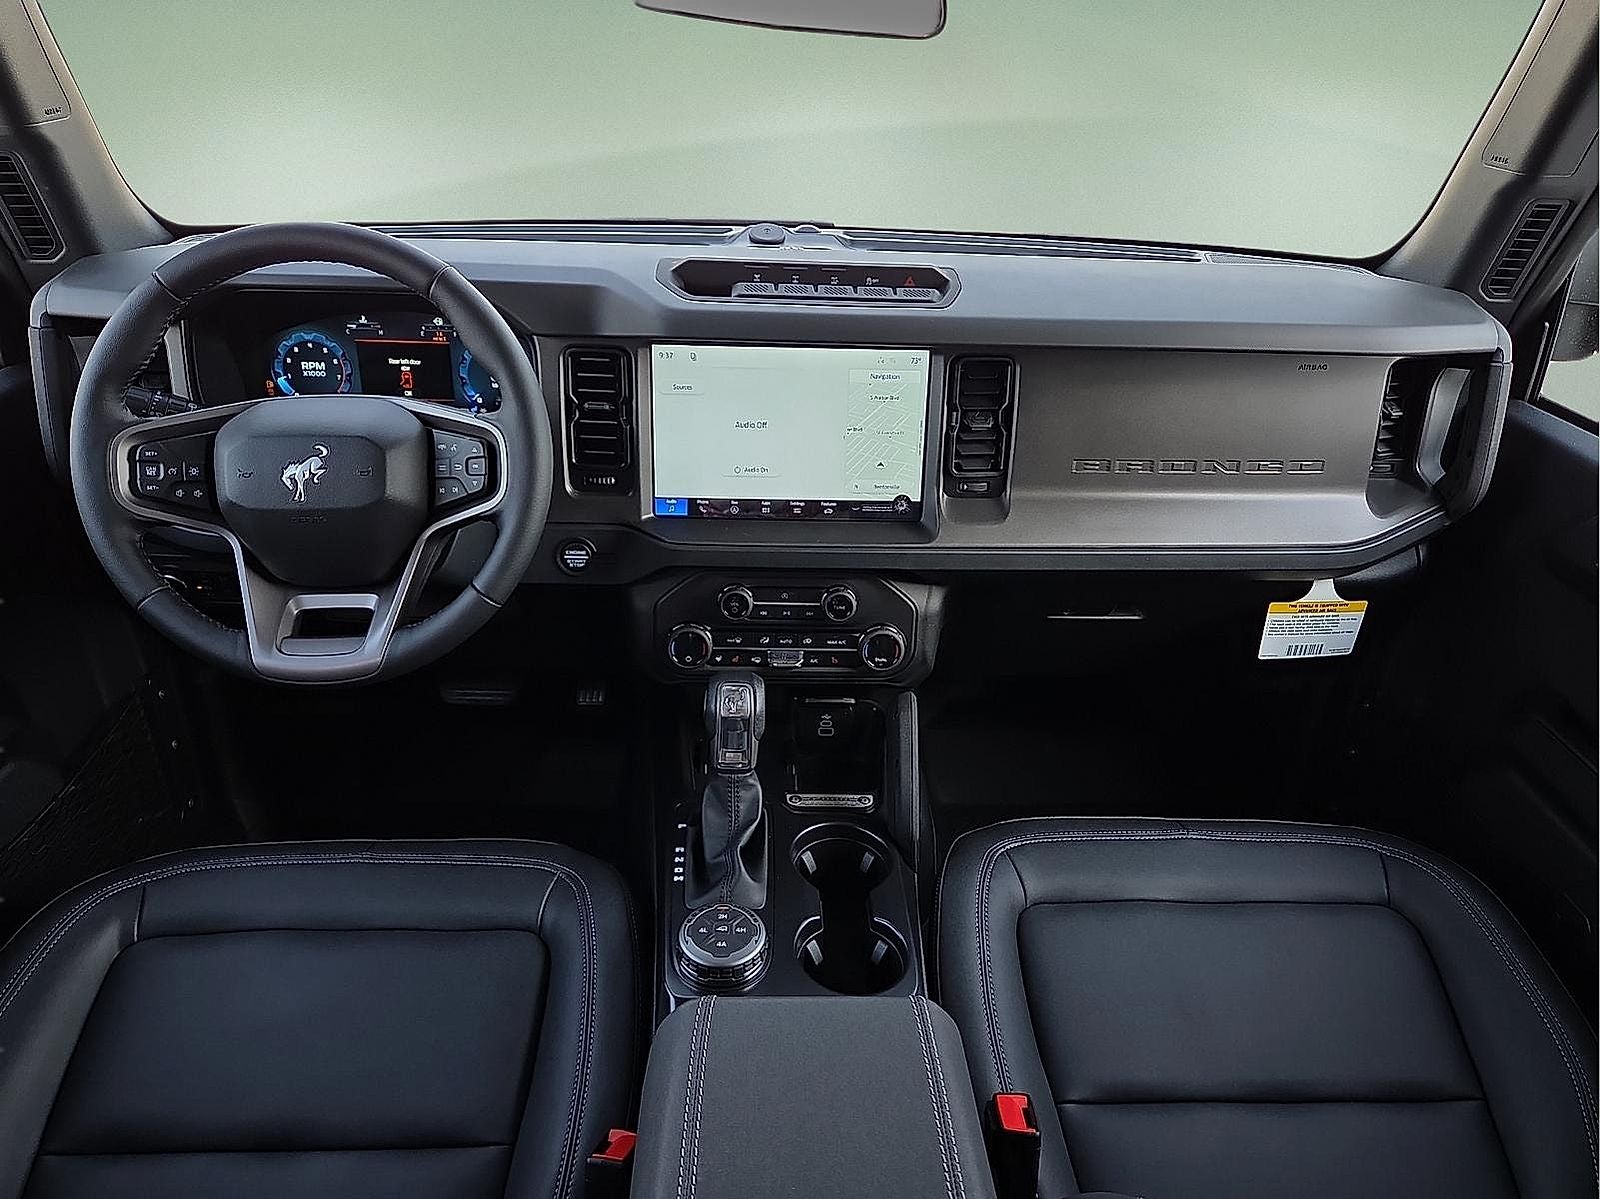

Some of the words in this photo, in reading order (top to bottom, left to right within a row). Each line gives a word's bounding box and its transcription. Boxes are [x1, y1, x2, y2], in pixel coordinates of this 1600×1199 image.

[300, 361, 326, 371] RPM
[869, 373, 901, 381] Navigation
[672, 383, 693, 391] Sources
[734, 420, 756, 429] Audio
[756, 420, 769, 430] Off
[1071, 458, 1326, 475] BRONCO
